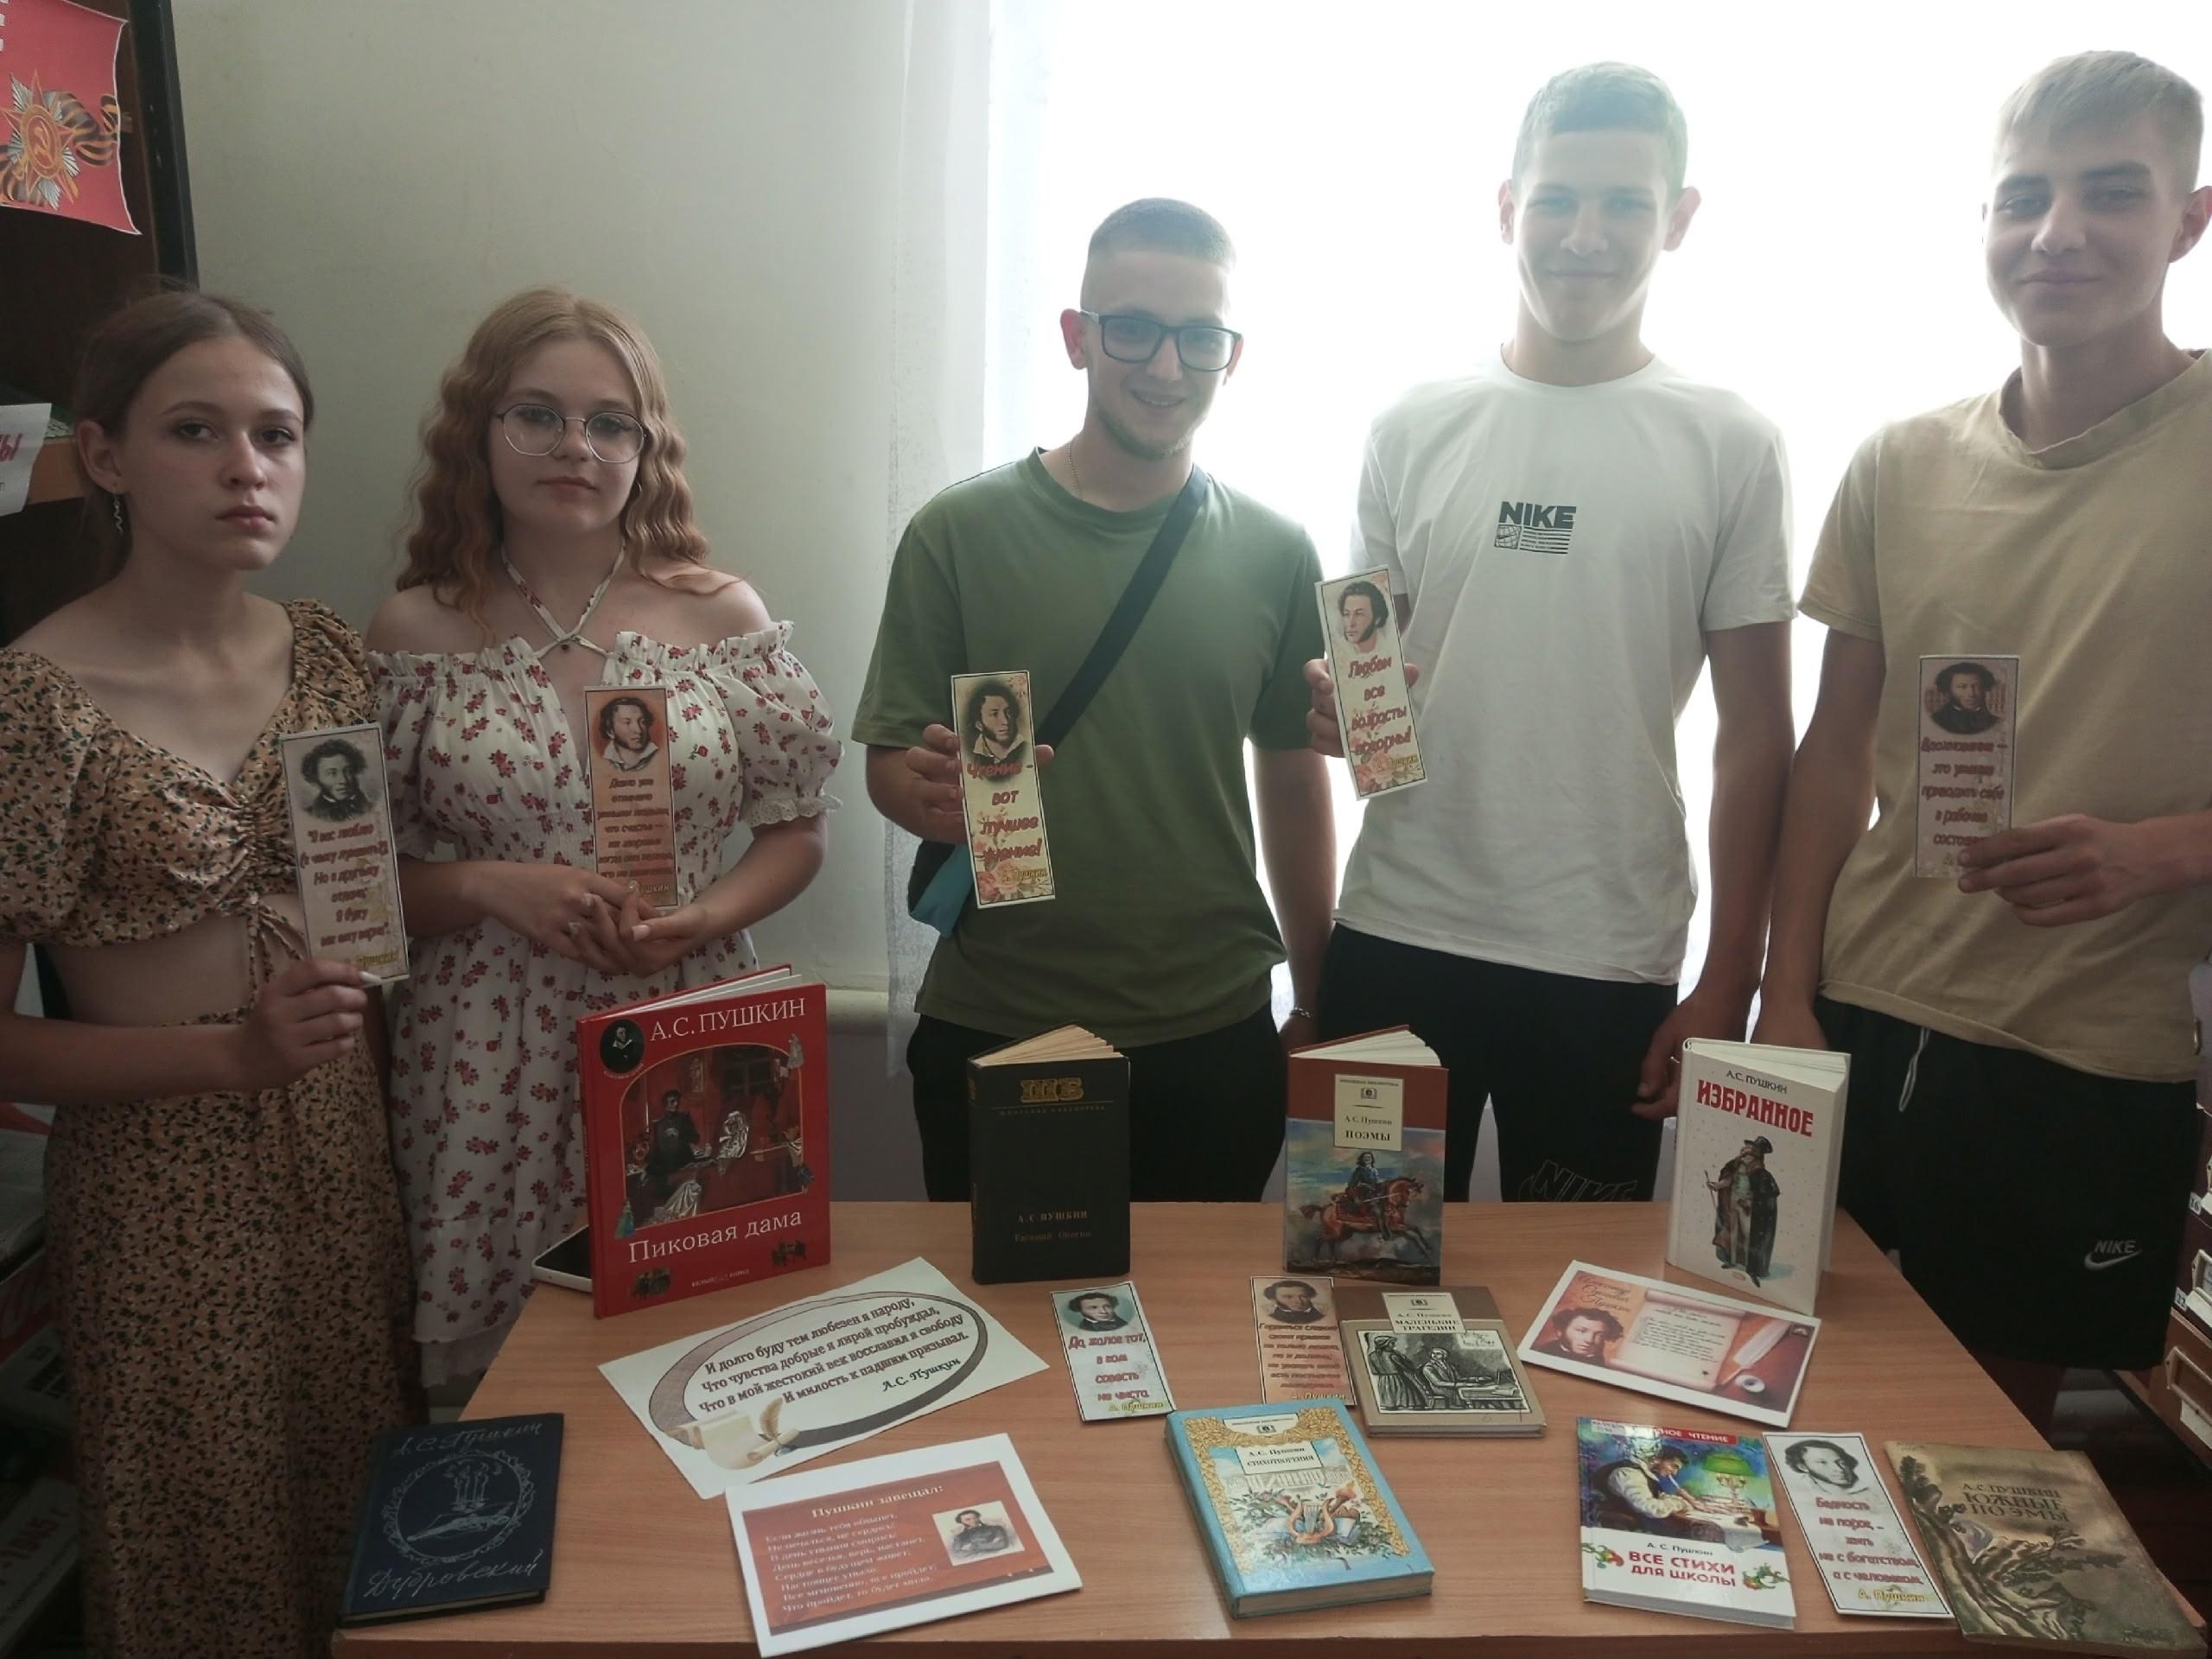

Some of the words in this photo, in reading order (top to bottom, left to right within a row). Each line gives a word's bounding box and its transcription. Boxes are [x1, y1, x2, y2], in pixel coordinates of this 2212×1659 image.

[1498, 501, 1576, 529] NIKE
[1348, 655, 1391, 678] Любви
[1351, 705, 1407, 731] возрасты
[981, 816, 1039, 836] лучшее
[650, 1017, 695, 1041] А.С.
[698, 998, 806, 1033] ПУШКИН
[1745, 1075, 1788, 1094] ПУШКИН
[1696, 1079, 1814, 1137] ИЗБРАННОЕ
[1346, 1130, 1390, 1141] ПОЭМЫ
[628, 1225, 738, 1263] Пиковая
[745, 1211, 803, 1238] дама
[2094, 1240, 2137, 1253] NIKE
[704, 1363, 717, 1375] И
[719, 1351, 754, 1372] долго
[755, 1341, 785, 1360] буду
[786, 1332, 810, 1346] тем
[811, 1314, 861, 1338] любезен
[862, 1313, 870, 1322] я
[871, 1298, 915, 1319] народу,
[1089, 1336, 1122, 1346] жалок
[702, 1378, 728, 1393] Что
[728, 1363, 779, 1386] чувства
[780, 1346, 827, 1371] добрые
[827, 1341, 836, 1351] я
[836, 1327, 874, 1349] лирой
[874, 1306, 940, 1334] пробуждал,
[699, 1399, 725, 1413] Что
[727, 1396, 736, 1405] в
[738, 1385, 764, 1401] мой
[764, 1363, 826, 1391] жестокий
[827, 1356, 849, 1370] век
[849, 1333, 910, 1361] восславил
[911, 1331, 918, 1340] я
[919, 1313, 963, 1337] свободу
[782, 1391, 796, 1403] И
[797, 1374, 849, 1399] милость
[850, 1370, 860, 1381] к
[861, 1353, 908, 1376] падшим
[909, 1332, 969, 1359] призывал.
[910, 1358, 961, 1380] Пушкин
[1096, 1372, 1140, 1383] совесть
[1688, 1431, 1728, 1443] ЧТЕНИЕ
[811, 1499, 874, 1518] Пушкин
[879, 1484, 944, 1505] завещал:
[1963, 1492, 2062, 1510] ЮЖНЫЕ
[1988, 1484, 2062, 1498] ПУШКИН
[1815, 1497, 1871, 1511] Бедность
[1971, 1503, 2069, 1522] ПОЭМЫ
[1819, 1516, 1834, 1526] не
[1672, 1545, 1713, 1556] Пушкин
[1846, 1536, 1874, 1547] жить
[1628, 1551, 1664, 1566] ВСЕ
[1670, 1557, 1736, 1574] СТИХИ
[1819, 1552, 1834, 1561] не
[363, 1548, 544, 1600] Дубровский
[1630, 1566, 1664, 1578] ДЛЯ
[1669, 1571, 1737, 1587] ШКОЛЫ
